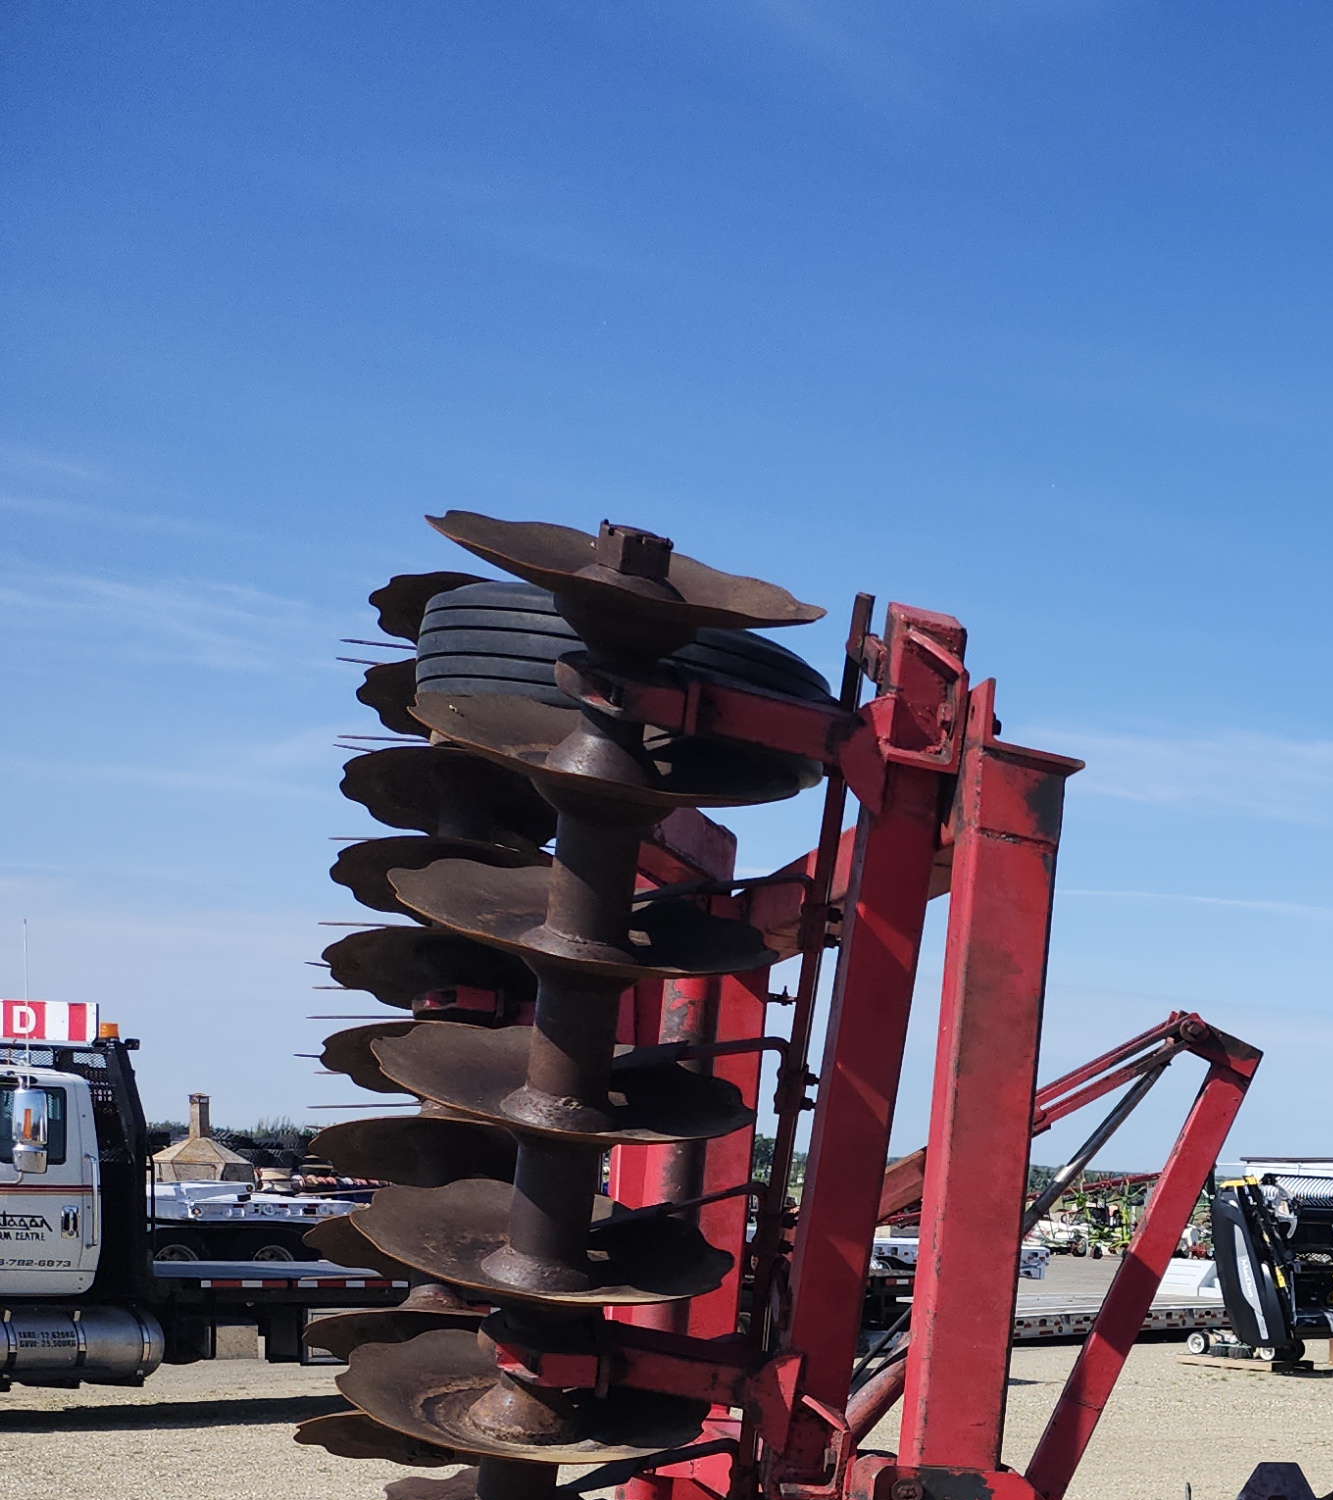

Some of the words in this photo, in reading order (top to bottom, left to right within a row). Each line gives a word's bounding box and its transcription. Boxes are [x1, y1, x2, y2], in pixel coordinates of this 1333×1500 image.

[12, 1005, 37, 1034] D
[0, 1210, 53, 1232] tagon
[15, 1231, 45, 1241] CENTRE
[1241, 1258, 1254, 1298] MacDon
